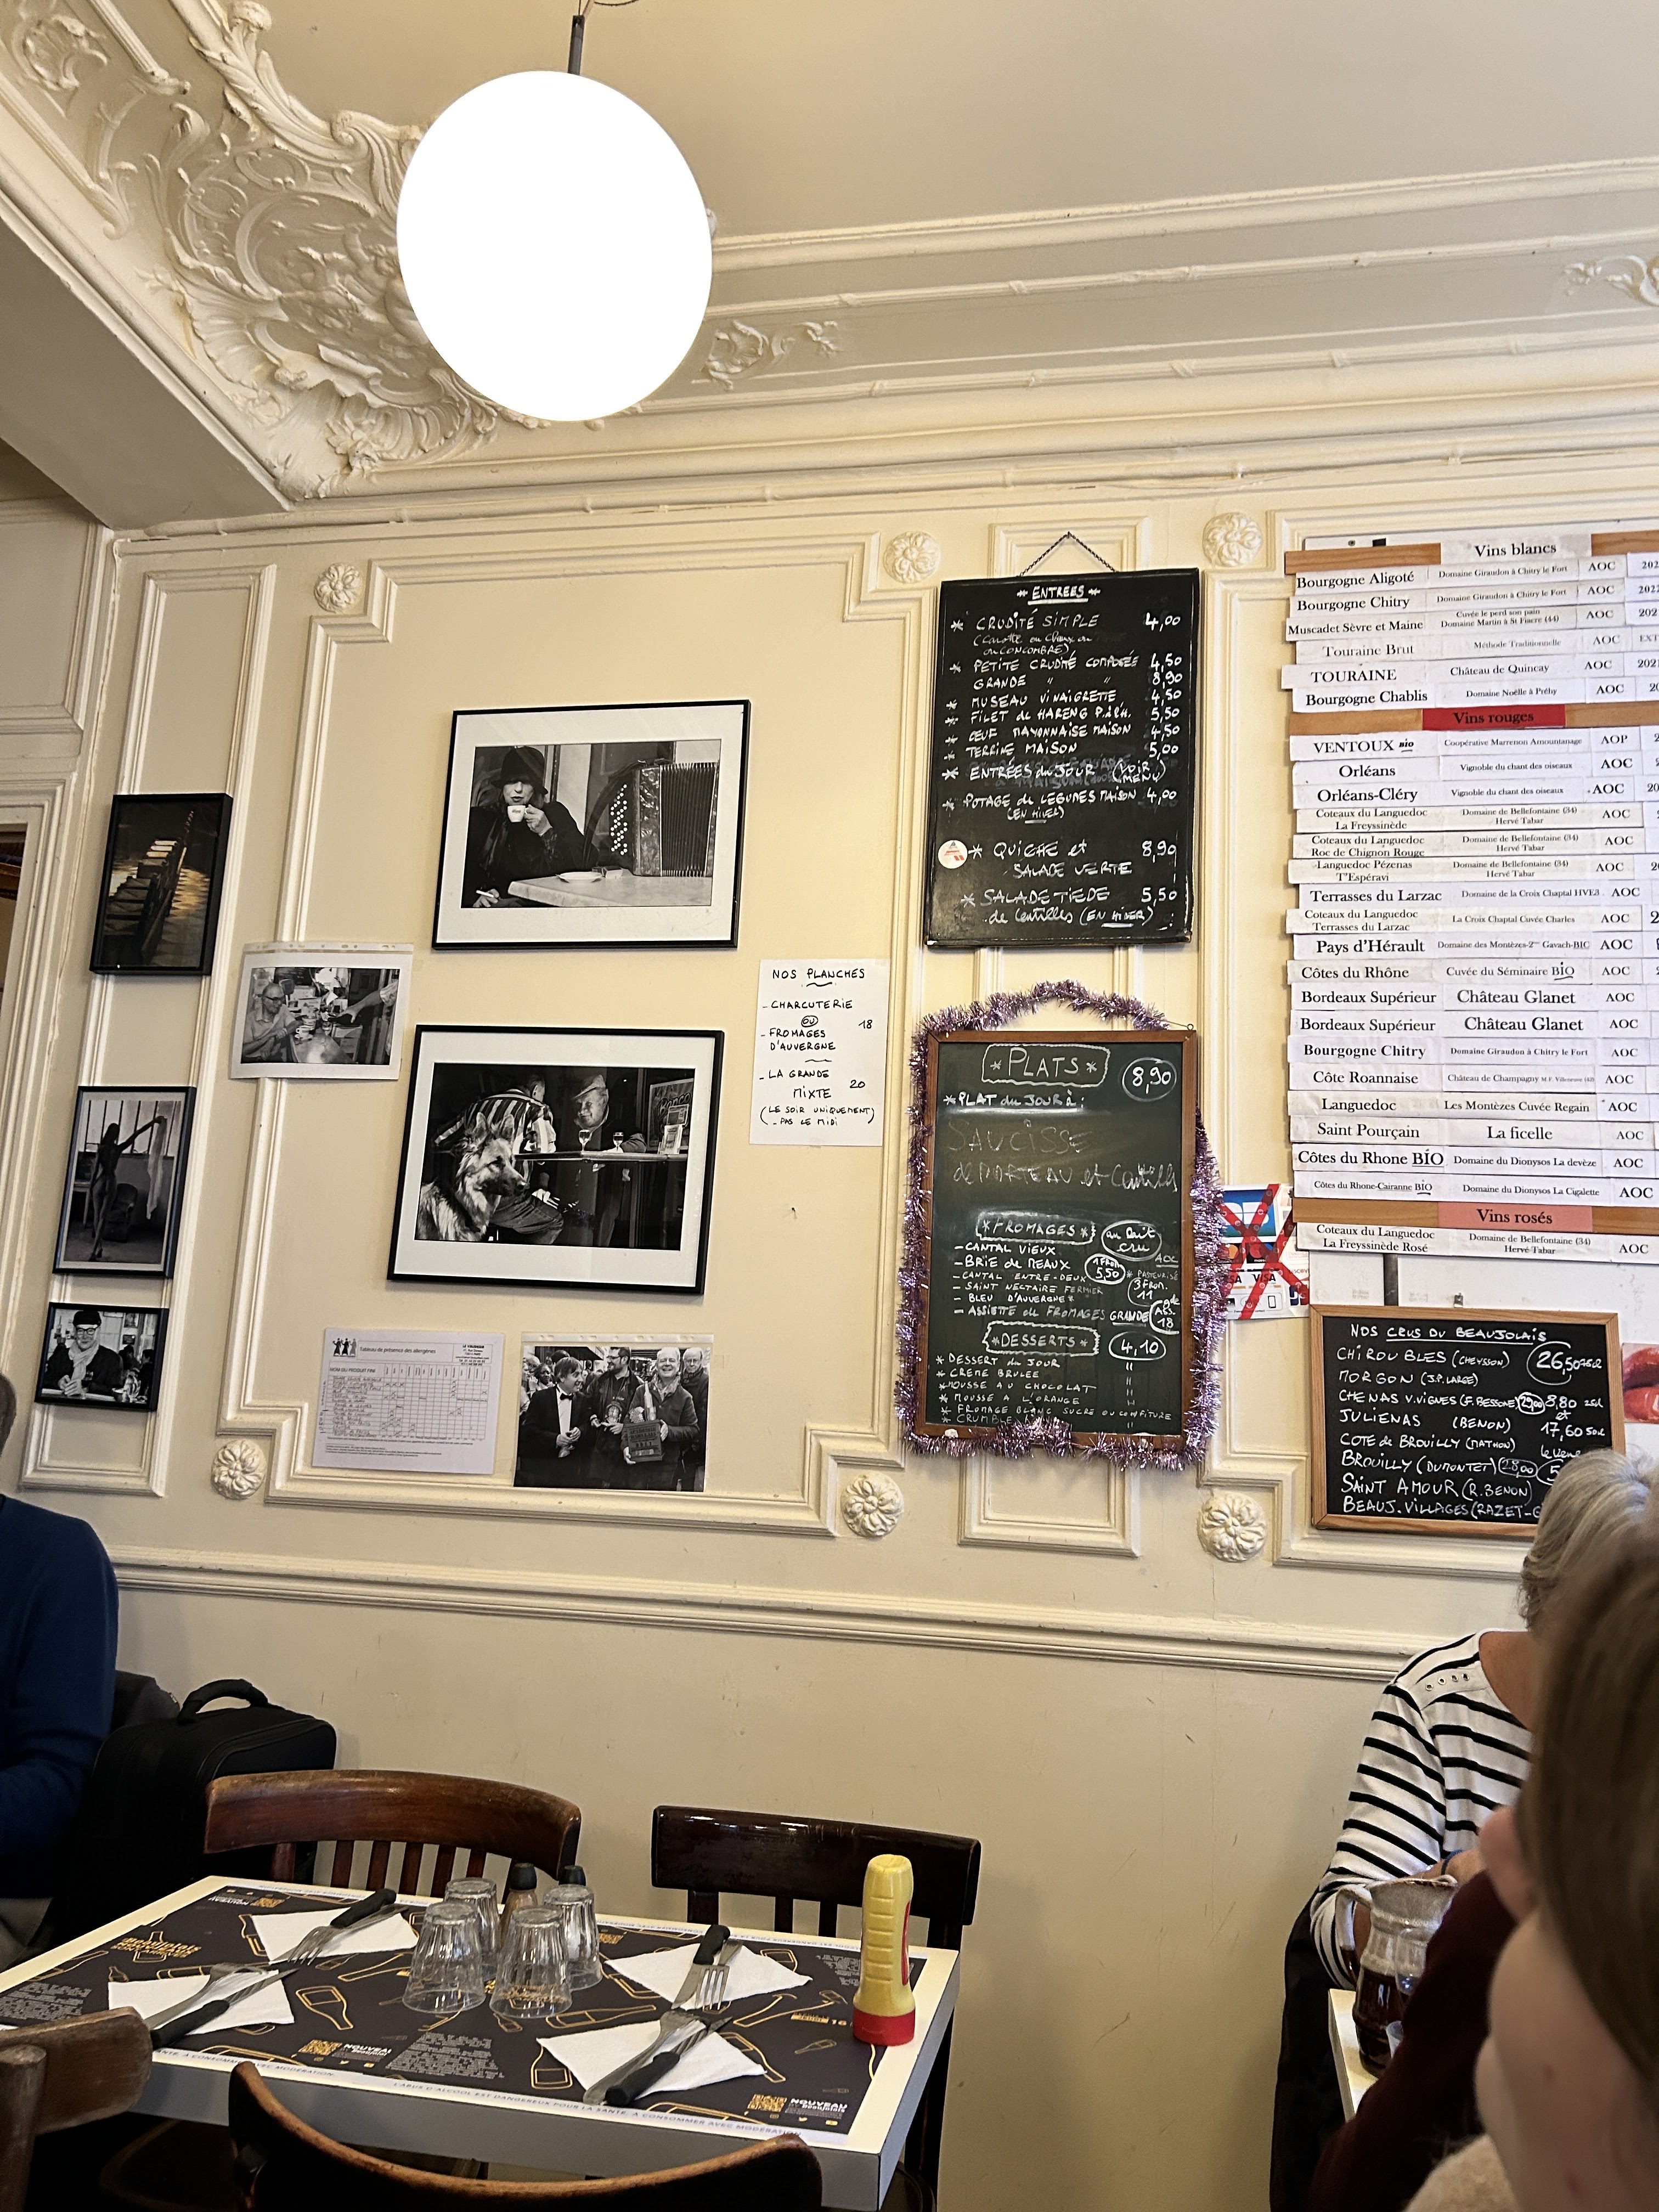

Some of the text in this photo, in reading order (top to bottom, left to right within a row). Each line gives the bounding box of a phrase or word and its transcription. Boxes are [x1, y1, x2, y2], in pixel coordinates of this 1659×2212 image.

[1475, 543, 1556, 557] Vins blancs
[1297, 576, 1365, 589] Bourgogne
[1369, 572, 1414, 585] Aligoté
[1518, 567, 1540, 575] Chitry
[1552, 565, 1567, 573] Fort
[1588, 562, 1616, 571] AOC
[1032, 585, 1084, 600] ENTREES
[1297, 585, 1615, 612] Bourgogne Chitry AOC
[1145, 612, 1181, 632] 4,00
[1288, 620, 1423, 634] Muscadet Sèvre et Maine
[1323, 644, 1414, 657] Touraine Brut
[1151, 653, 1182, 672] 4,50
[1311, 661, 1612, 682] TOURAINE Château de AOC
[973, 671, 1183, 690] GRANDE 8,90
[971, 689, 1182, 708] MUSEAU 4,50
[1306, 684, 1624, 707] Bourgogne Chablis AOC
[1037, 707, 1180, 723] HARENG 5,50
[1453, 712, 1534, 725] Vins rouges
[1151, 724, 1180, 742] 4,50
[1149, 742, 1179, 760] 5,00
[1313, 735, 1628, 753] VENTOUX Coopérative AOP
[1339, 758, 1633, 778] Orléans Vignoble AOC
[963, 793, 1011, 809] POTAGE
[1318, 784, 1624, 804] Orléans-Cléry AOC
[1316, 809, 1355, 819] Coteaux
[1358, 808, 1370, 818] du
[1374, 808, 1427, 819] Languedoc
[1511, 806, 1560, 815] Bellefontaine
[1335, 821, 1407, 831] La Freyssinède
[1068, 839, 1087, 857] et
[1013, 861, 1132, 878] SALADE VERTE
[980, 889, 1051, 906] SALADE
[1310, 888, 1640, 903] Terrasses du Larzac AOC
[1316, 938, 1633, 955] Pays d'Hérault AOC
[773, 968, 865, 979] NOS PLANCHES
[1301, 966, 1548, 979] Côtes du Rhône Cuvée Séminaire
[1301, 990, 1635, 1007] Bordeaux Supérieur Château Glanet AOC
[770, 1020, 873, 1037] FROMAGES 18
[1301, 1017, 1584, 1035] Bordeaux Supérieur Château Glanet
[771, 1040, 836, 1051] D'AUVERGNE
[1304, 1045, 1426, 1059] Bourgogne Chitry
[769, 1069, 829, 1079] LA GRANDE
[1132, 1066, 1171, 1094] 8,90
[1313, 1071, 1634, 1084] Côte Roannaise Champagny AOC
[850, 1080, 865, 1088] 20
[1024, 1094, 1063, 1106] JOUR
[1322, 1098, 1589, 1114] Languedoc Les Montèzes Cuvée Regain
[1318, 1122, 1553, 1141] Saint Pourçain La ficelle
[1298, 1151, 1550, 1167] Côtes du Rhone Domaine du Dionysos
[1619, 1187, 1653, 1198] AOC
[1476, 1209, 1553, 1224] Vins rosés
[993, 1220, 1076, 1237] FROMAGES
[1317, 1224, 1649, 1254] Coteaux du Languedoc AOC
[1340, 1239, 1428, 1252] Freyssinède Rosé
[965, 1242, 1012, 1254] CANTAL
[962, 1271, 1003, 1280] CANTAL
[969, 1293, 993, 1302] BLEU
[1351, 1324, 1421, 1339] NOS CRUS
[1001, 1331, 1159, 1357] DESSERTS 4,10
[948, 1353, 998, 1366] DESSERT
[997, 1369, 1040, 1378] BRULEE
[1025, 1383, 1097, 1393] CHOCOLAT
[1339, 1390, 1577, 1409] CHENAS 8,80
[957, 1404, 1008, 1414] FROMAGE
[1340, 1433, 1376, 1447] COTE
[1397, 1480, 1459, 1497] AMOUR
